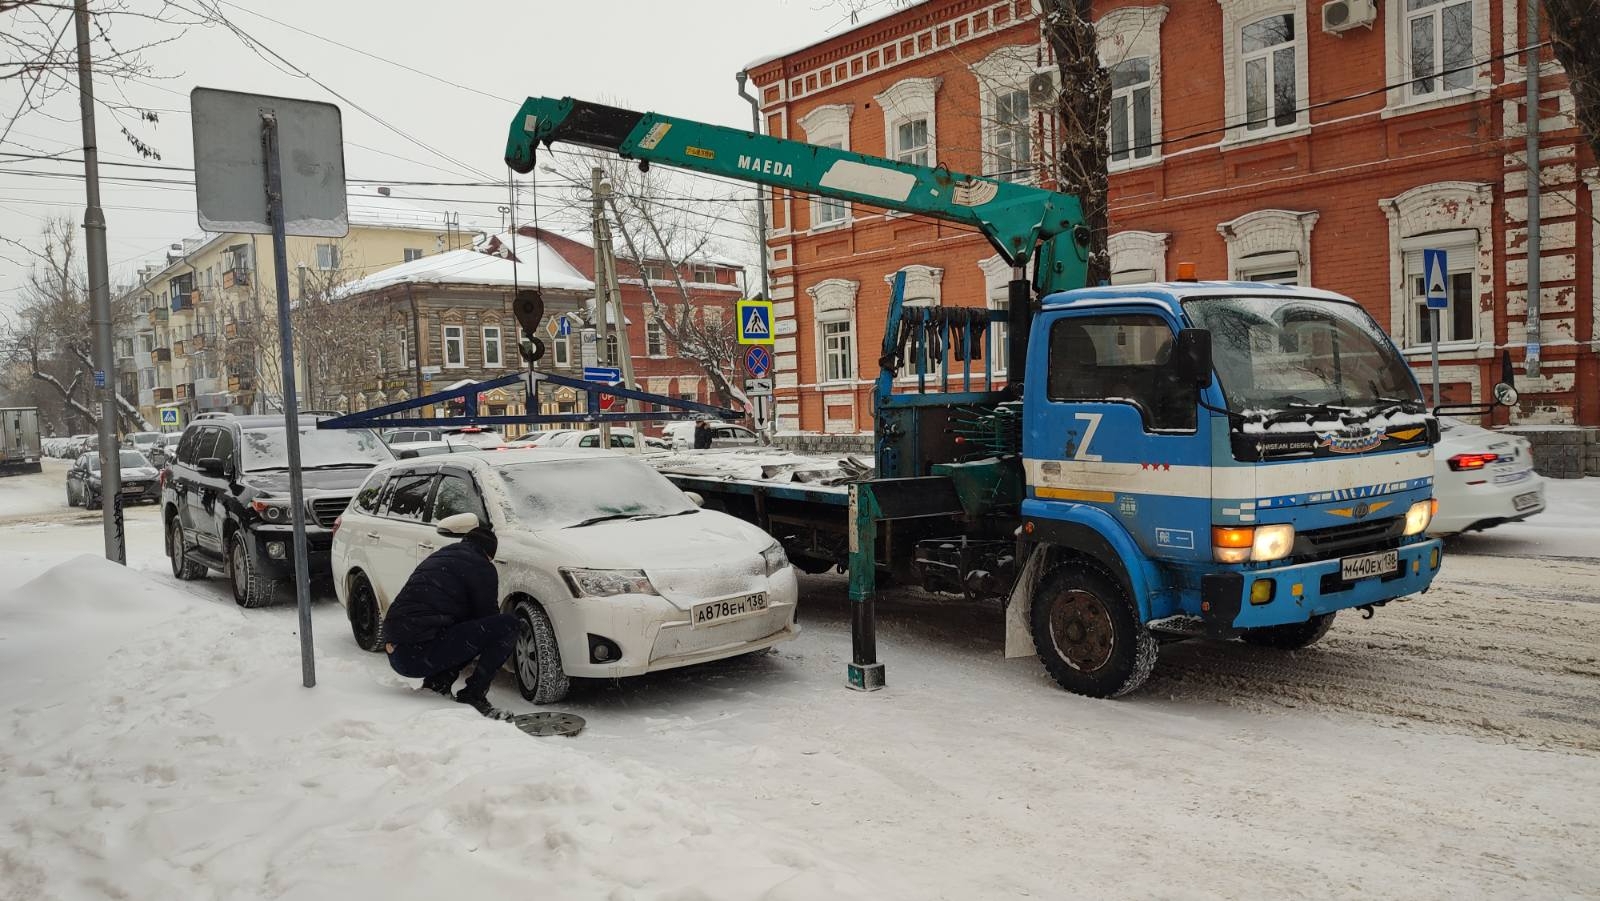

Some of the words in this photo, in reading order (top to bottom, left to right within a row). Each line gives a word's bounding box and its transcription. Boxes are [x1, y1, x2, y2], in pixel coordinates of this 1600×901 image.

[737, 154, 793, 178] MAEDA
[1074, 412, 1104, 462] Z
[698, 602, 745, 622] А878ЕН
[746, 594, 764, 607] 138
